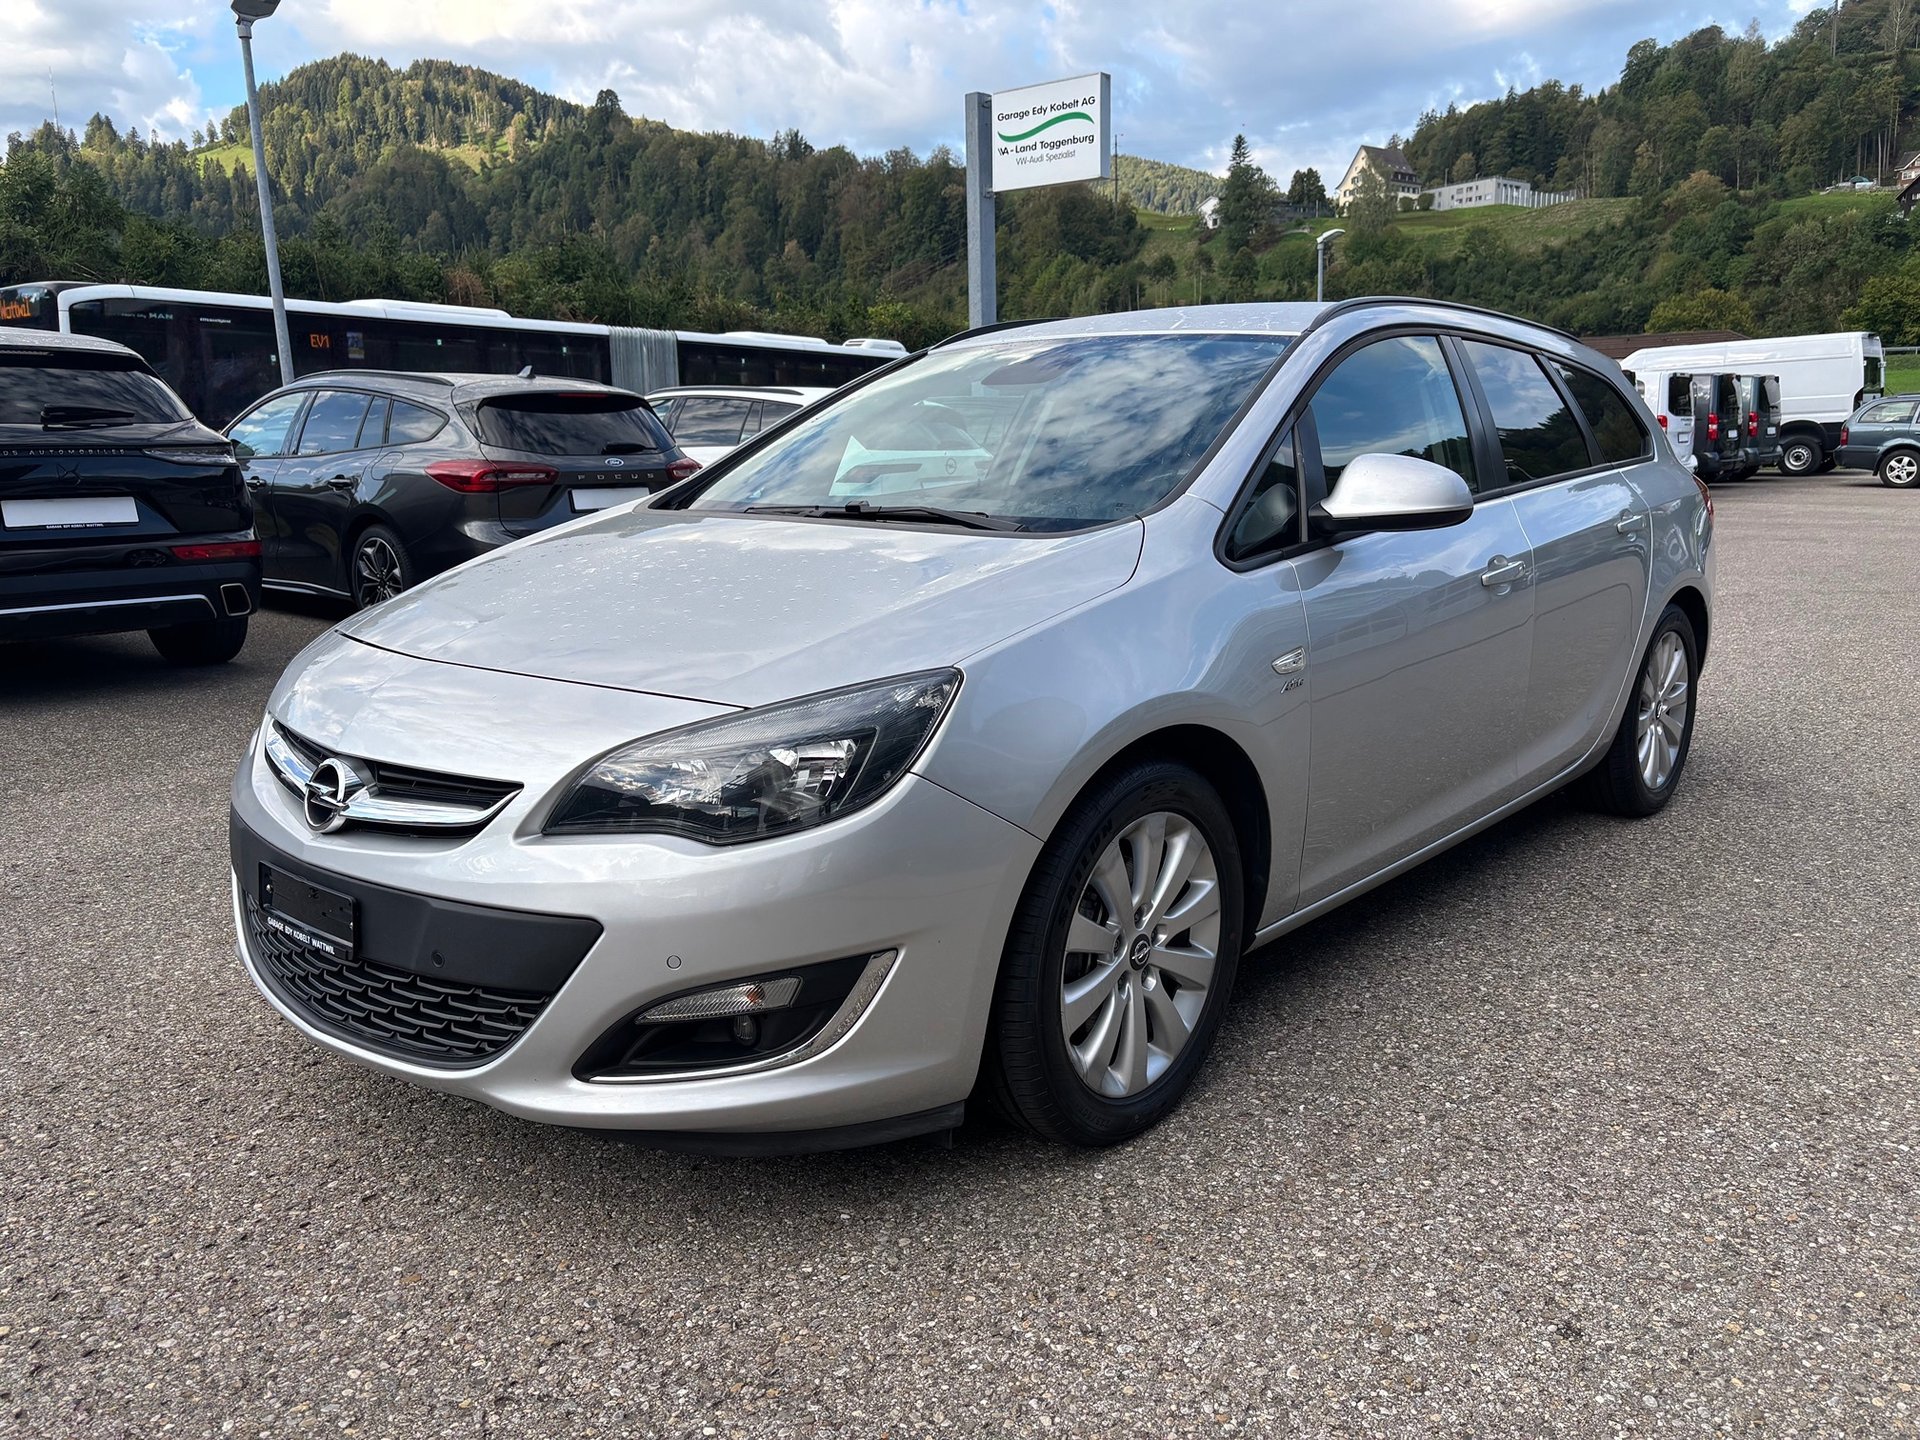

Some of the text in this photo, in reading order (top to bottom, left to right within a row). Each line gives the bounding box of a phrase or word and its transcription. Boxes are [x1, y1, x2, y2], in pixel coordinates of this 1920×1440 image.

[997, 96, 1096, 121] Garage Edy Kobelt AG
[1015, 141, 1037, 153] Land
[1040, 134, 1095, 150] Toggenburg
[1016, 149, 1076, 165] VW-Audi Spezialist
[310, 334, 330, 348] EV1
[267, 916, 335, 955] GARAGE EDY KOBELT WATTWIL
